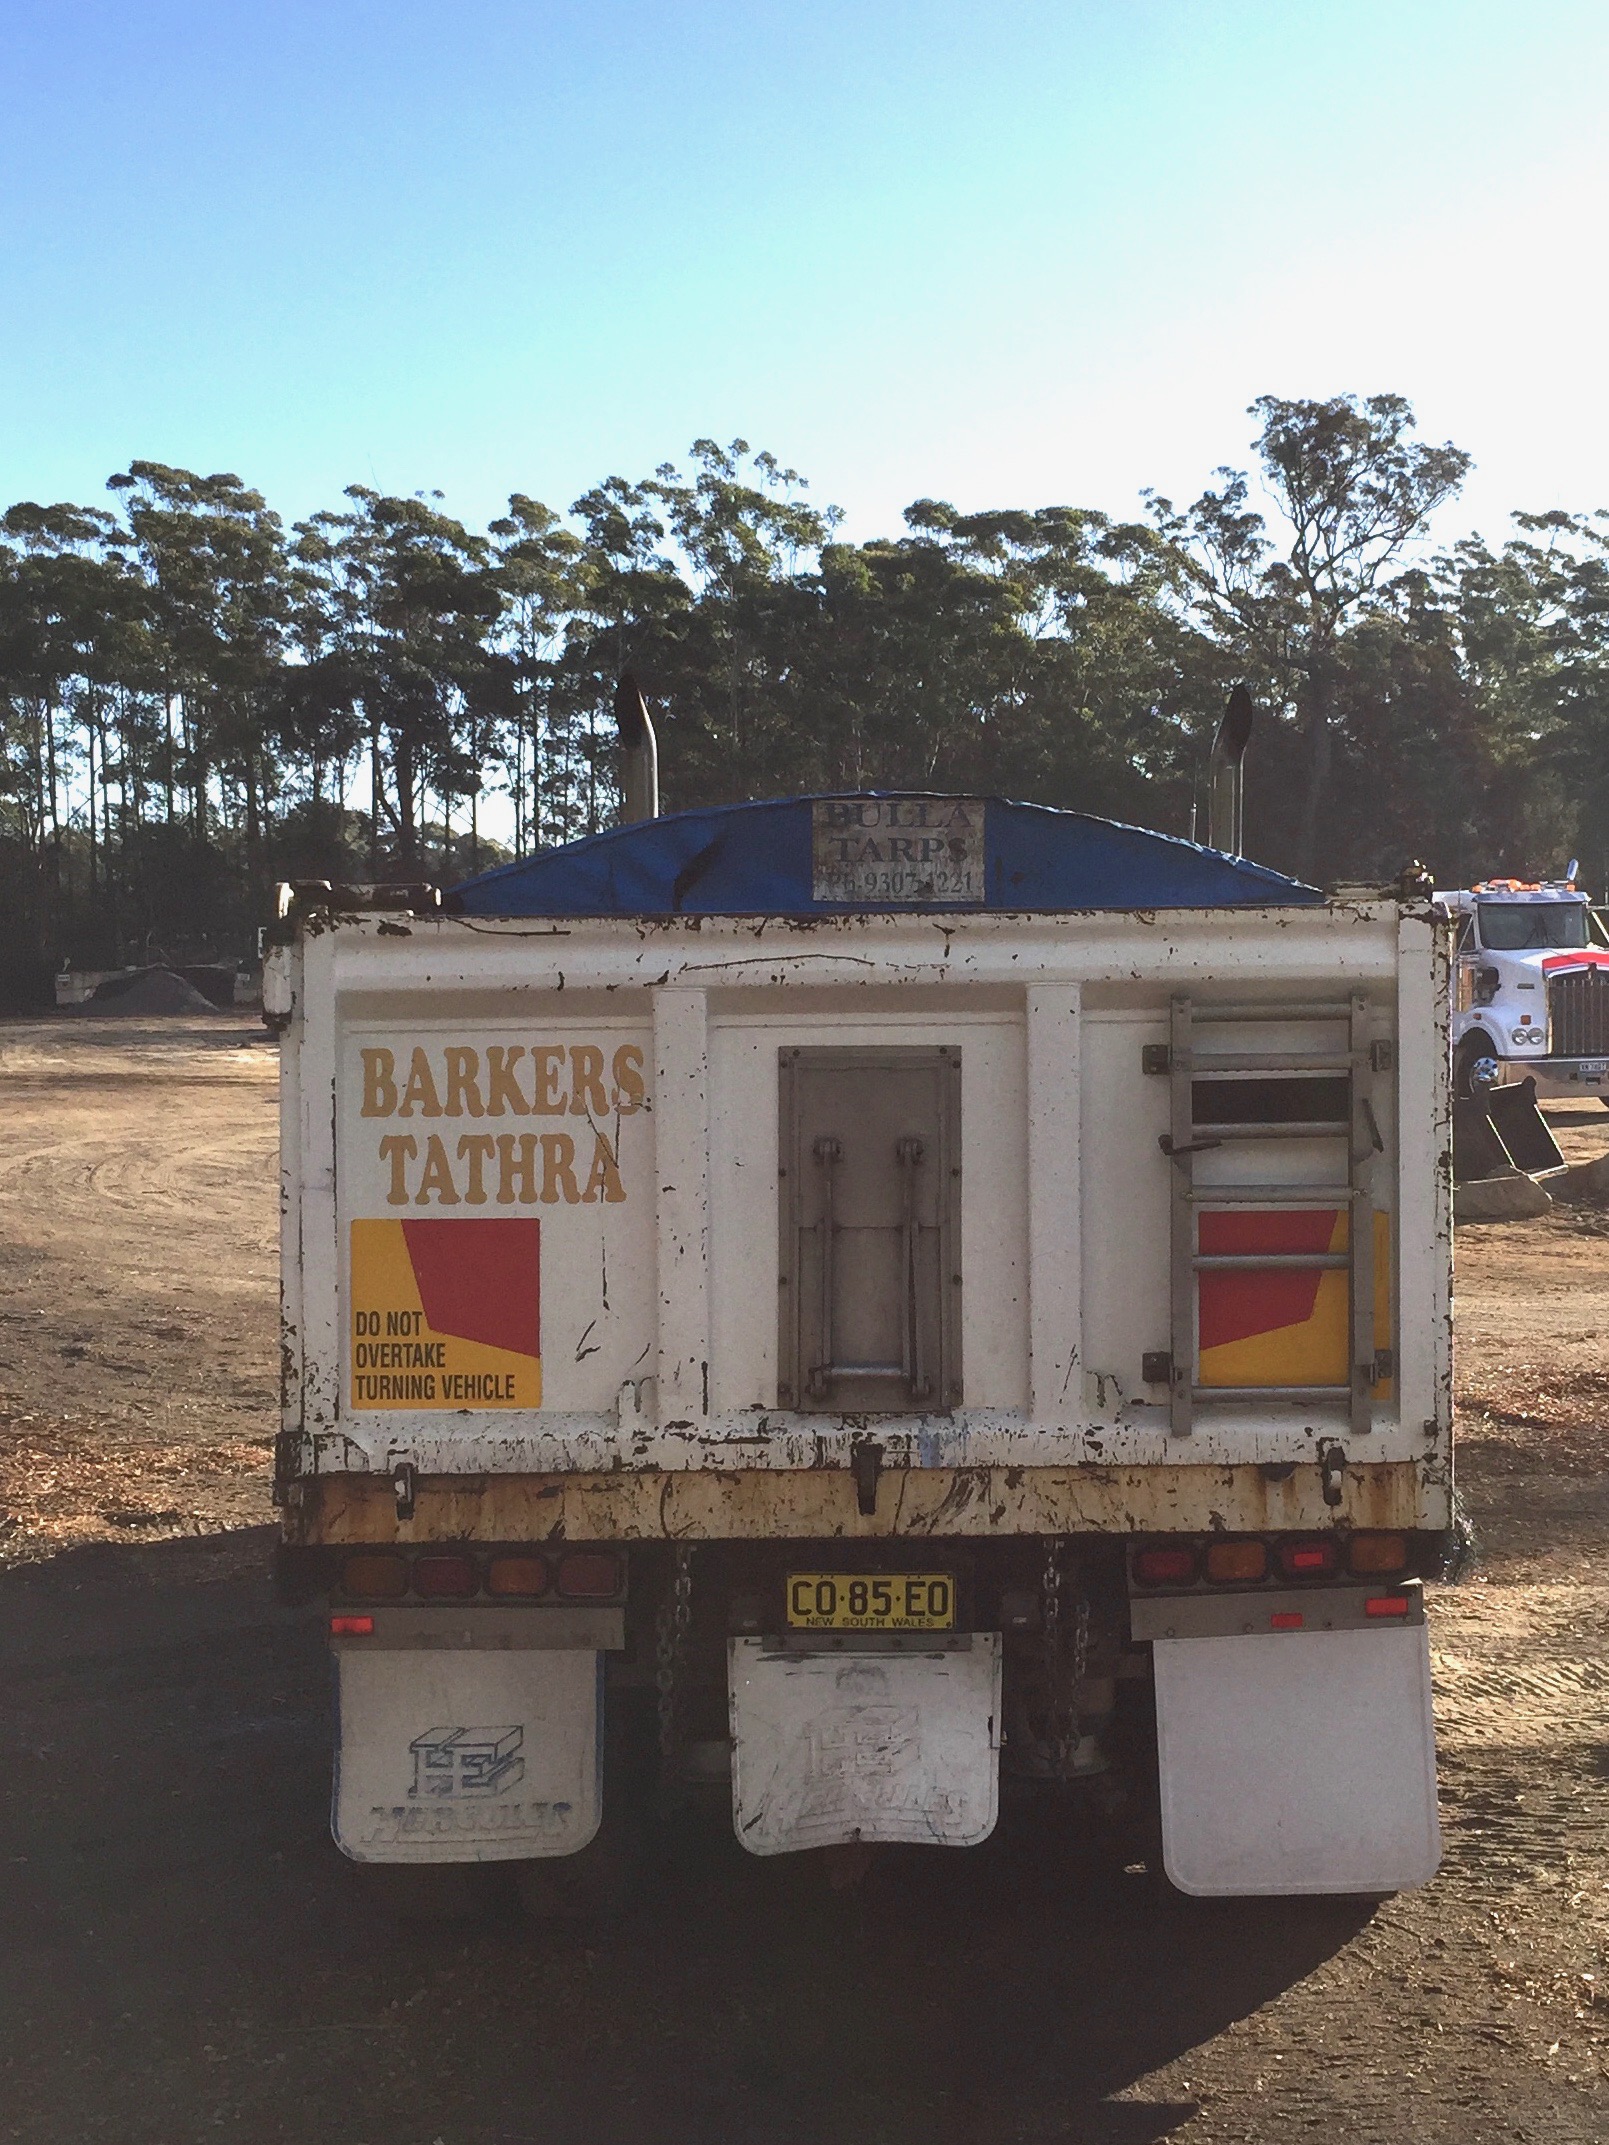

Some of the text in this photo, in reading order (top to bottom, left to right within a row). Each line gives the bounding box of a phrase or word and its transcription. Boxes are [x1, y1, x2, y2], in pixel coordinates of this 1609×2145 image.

[823, 802, 974, 828] BULLA
[828, 836, 968, 863] TARPS
[360, 1044, 645, 1118] BARKERS
[379, 1132, 627, 1205] TATHRA
[355, 1311, 422, 1336] DO NOT
[355, 1343, 446, 1368] OVERTAKE
[355, 1374, 516, 1400] TURNING VEHICLE
[806, 1616, 934, 1627] NEW SOUTH WALES
